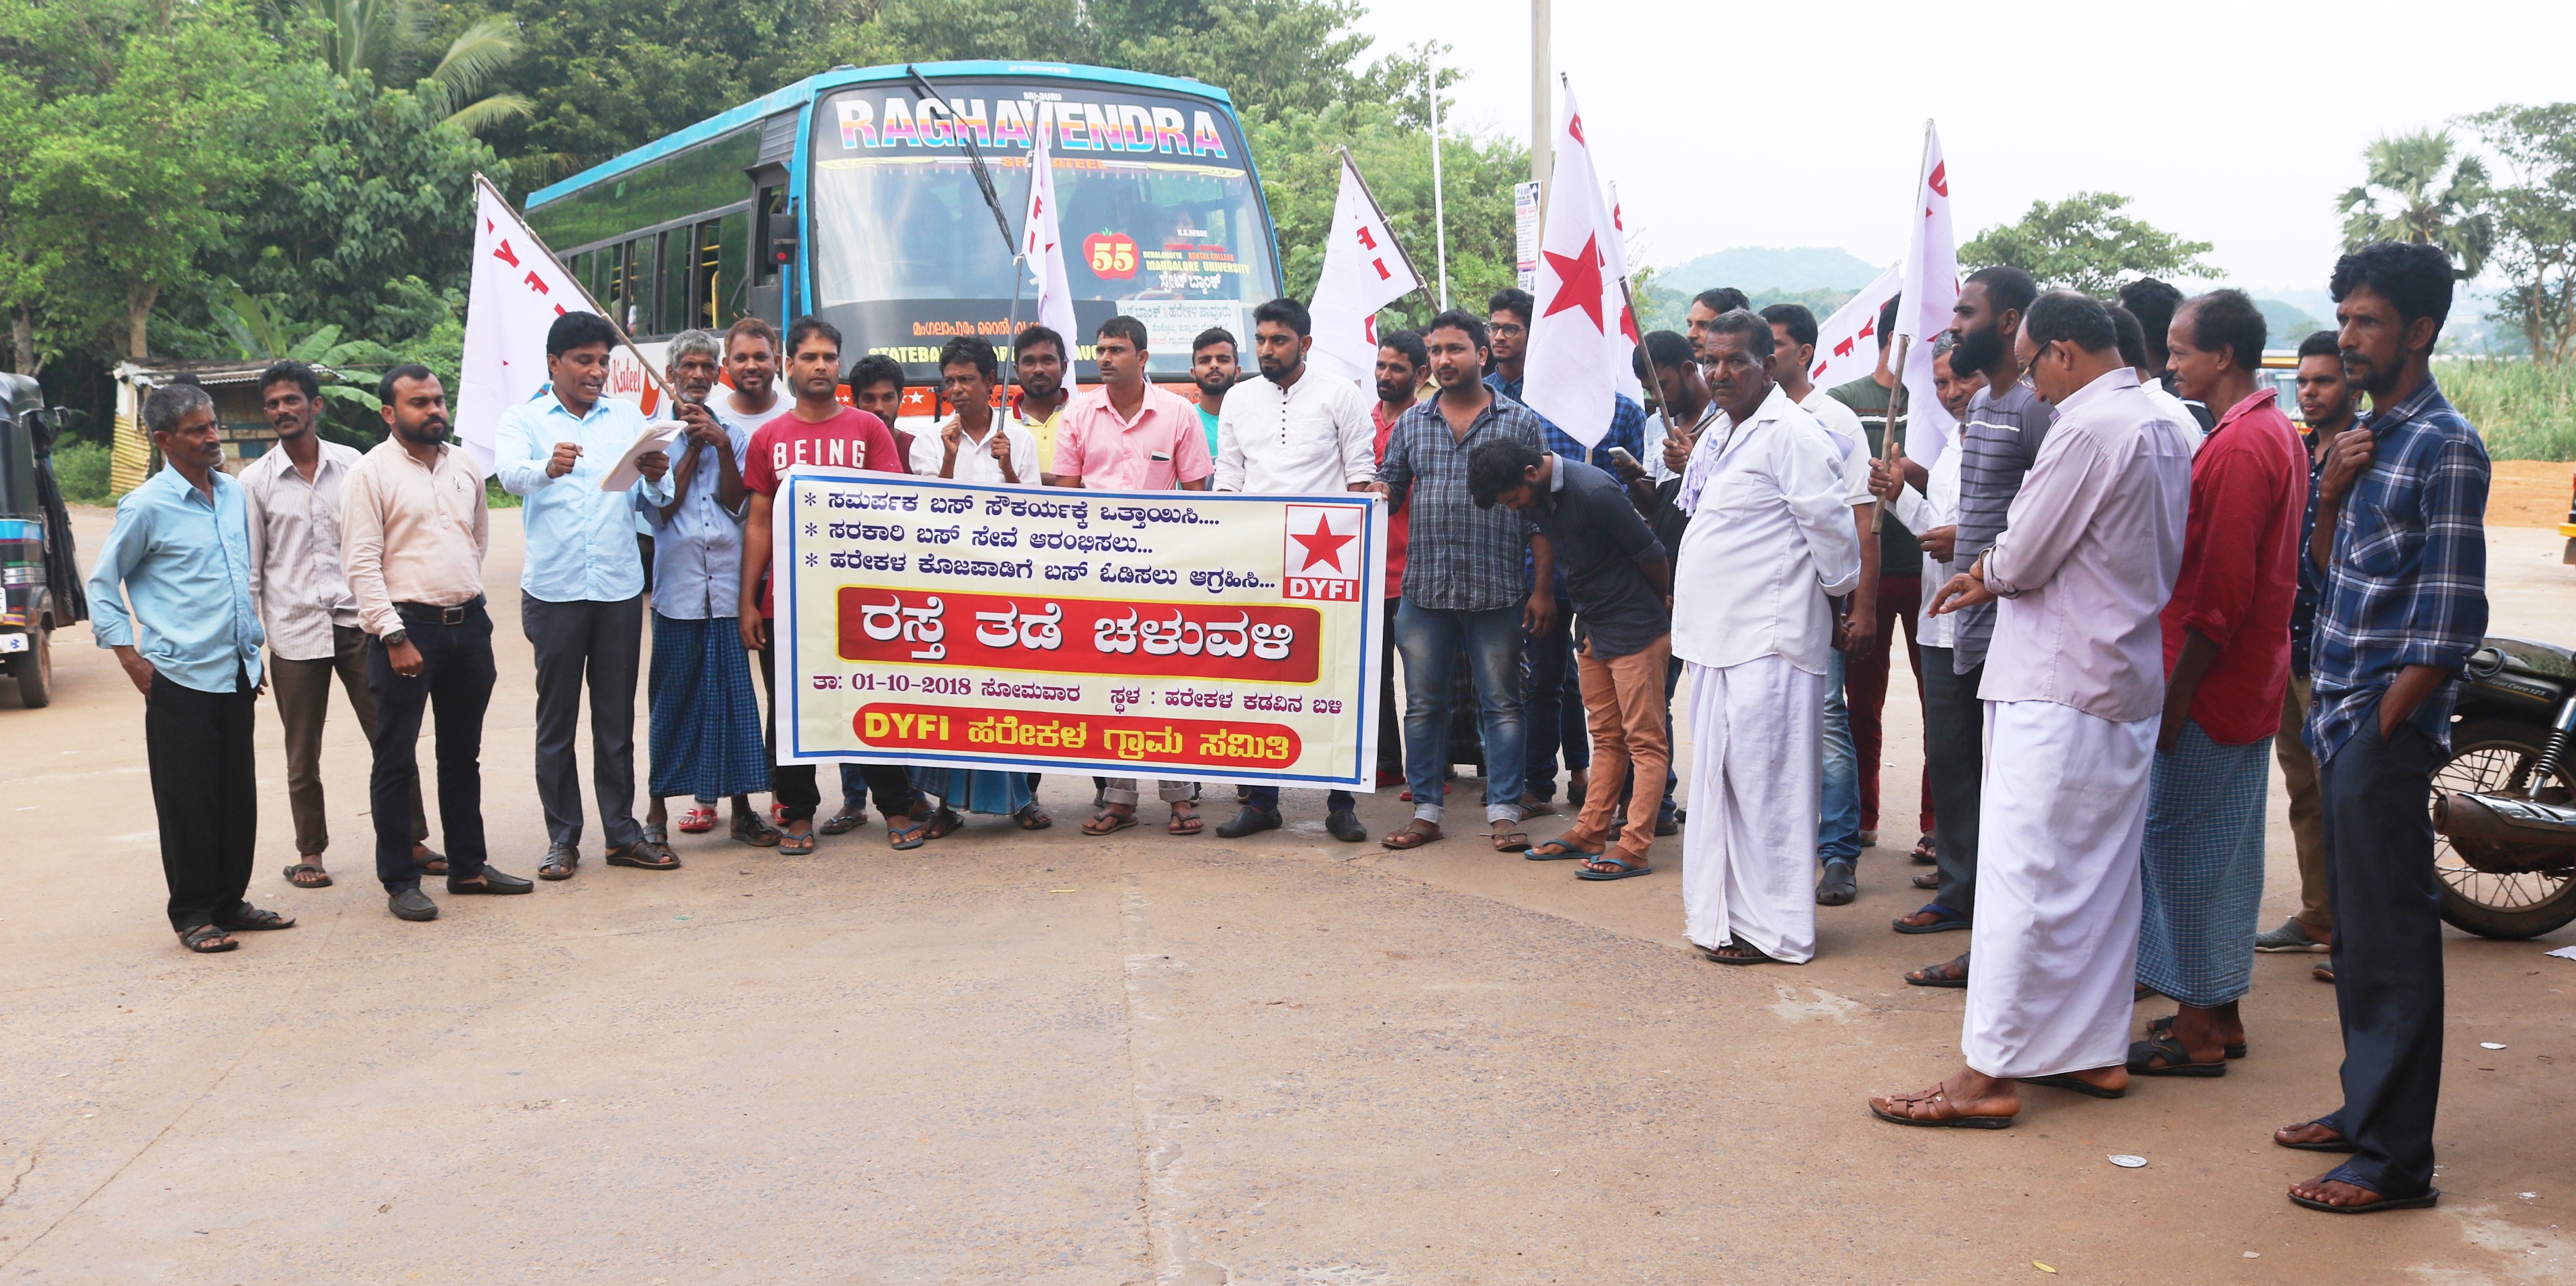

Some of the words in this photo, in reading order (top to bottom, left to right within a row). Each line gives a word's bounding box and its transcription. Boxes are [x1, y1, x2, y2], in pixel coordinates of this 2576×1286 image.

[836, 97, 1228, 159] RAGHAVENDRA
[1001, 156, 1026, 168] SR
[1050, 157, 1108, 170] ATEEL
[1092, 242, 1134, 271] 55
[1146, 261, 1200, 271] MANGALORE
[1202, 261, 1250, 274] UNIVERSITY
[1211, 254, 1235, 262] COLLEGE
[611, 358, 641, 394] Kateel
[773, 438, 865, 470] BEING
[828, 489, 919, 512] ಸಮರ್ಪಕ
[930, 495, 974, 514] ಬಸ್
[985, 495, 1089, 529] ಸೌಕರ್ಯಕ್ಕೆ
[829, 518, 905, 541] ಸರಕಾರಿ
[917, 525, 960, 544] ಬಸ್
[972, 526, 1018, 548] ಸೇವೆ
[830, 548, 907, 571] ಹರೇಕಳ
[918, 553, 1033, 579] ಕೊಜಪಾಡಿಗೆ
[1045, 561, 1088, 581] ಬಸ್
[1100, 562, 1177, 585] ಓಡಿಸಲು
[1290, 578, 1353, 600] DYFI
[861, 594, 947, 660] ರಸ್ತೆ
[975, 600, 1064, 650] ತಡೆ
[1094, 606, 1294, 660] ಚಳುವಳಿ
[851, 673, 972, 695] 01-10-2018
[981, 678, 1081, 702] ಸೋಮವಾರ
[1110, 685, 1140, 714] ಸ್ಥಳ
[1165, 687, 1234, 709] ಹರೇಕಳ
[1243, 692, 1303, 713] ಕಡವಿನ
[1313, 699, 1342, 715] ಬಳಿ
[864, 712, 949, 741] DYFI
[968, 715, 1087, 749] ಹರೇಕಳ
[1104, 726, 1183, 760] ಗ್ರಾಮ
[1199, 728, 1290, 760] ಸಮಿತಿ
